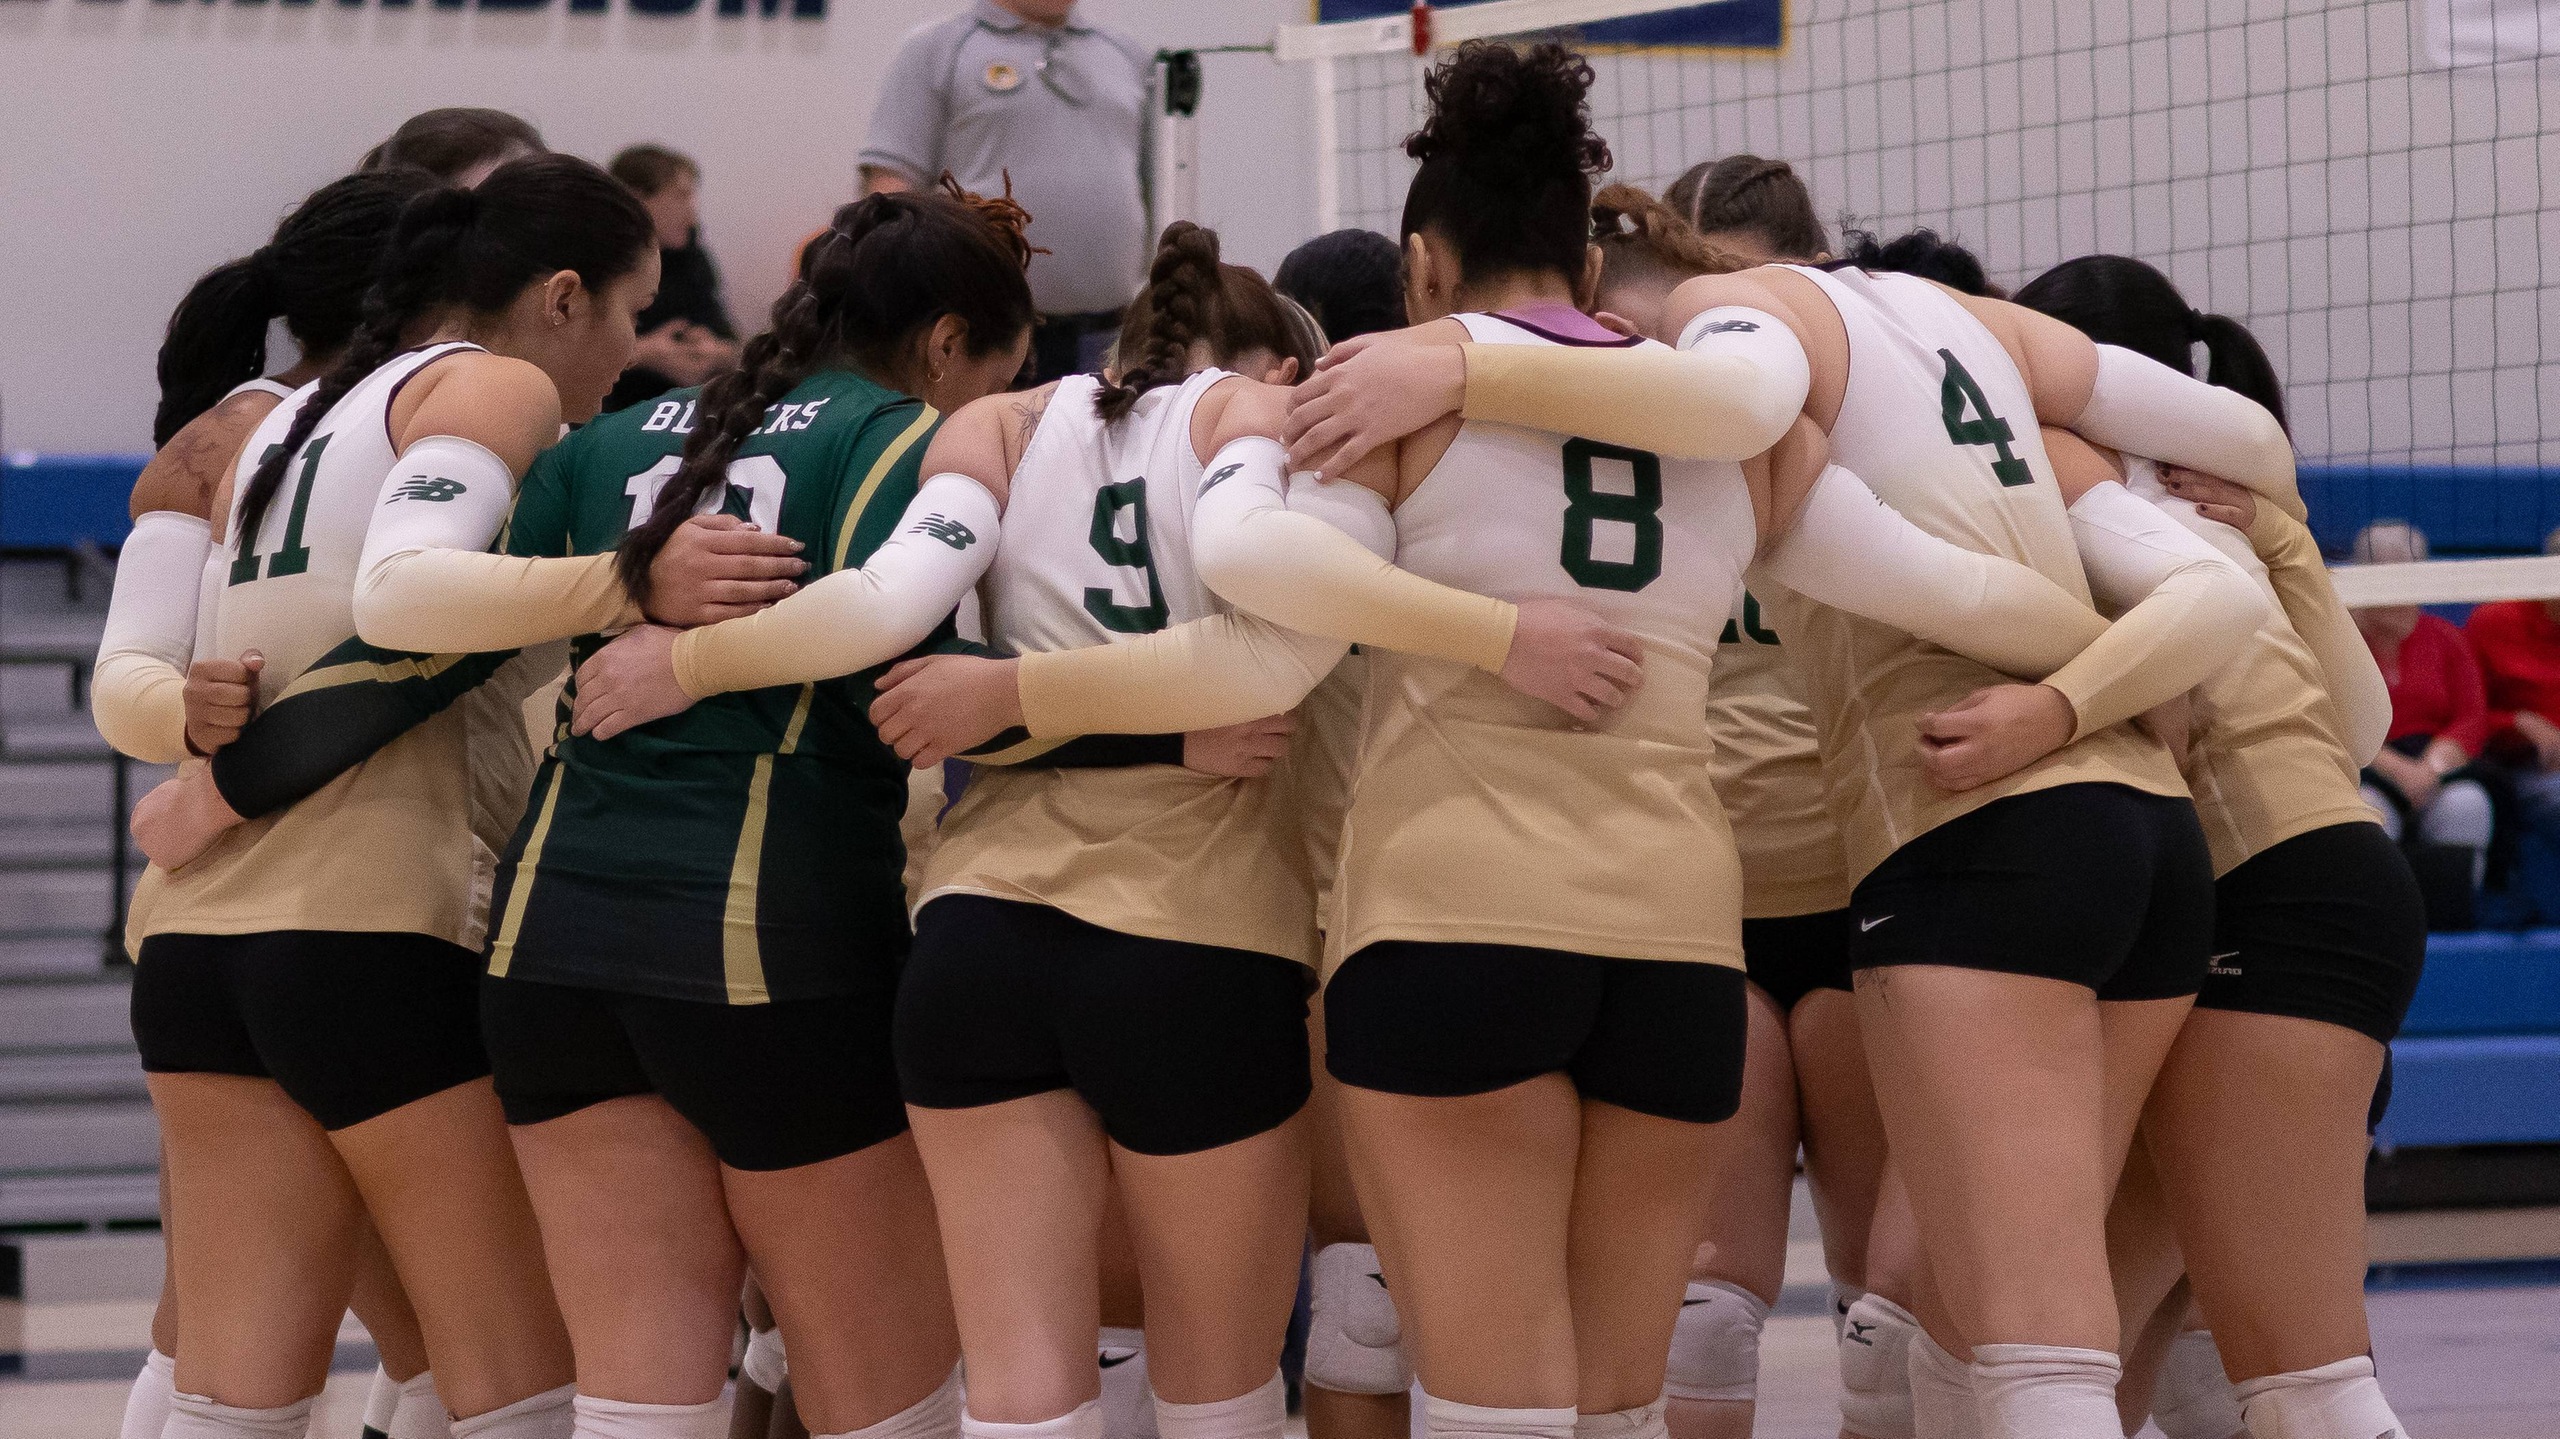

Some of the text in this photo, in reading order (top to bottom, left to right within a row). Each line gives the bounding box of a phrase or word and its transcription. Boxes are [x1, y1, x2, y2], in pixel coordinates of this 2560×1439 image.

[641, 397, 831, 436] BLRS
[1936, 347, 2036, 488] 4
[228, 431, 335, 587] 11
[1083, 475, 1171, 634] 9
[1560, 436, 1664, 593] 8
